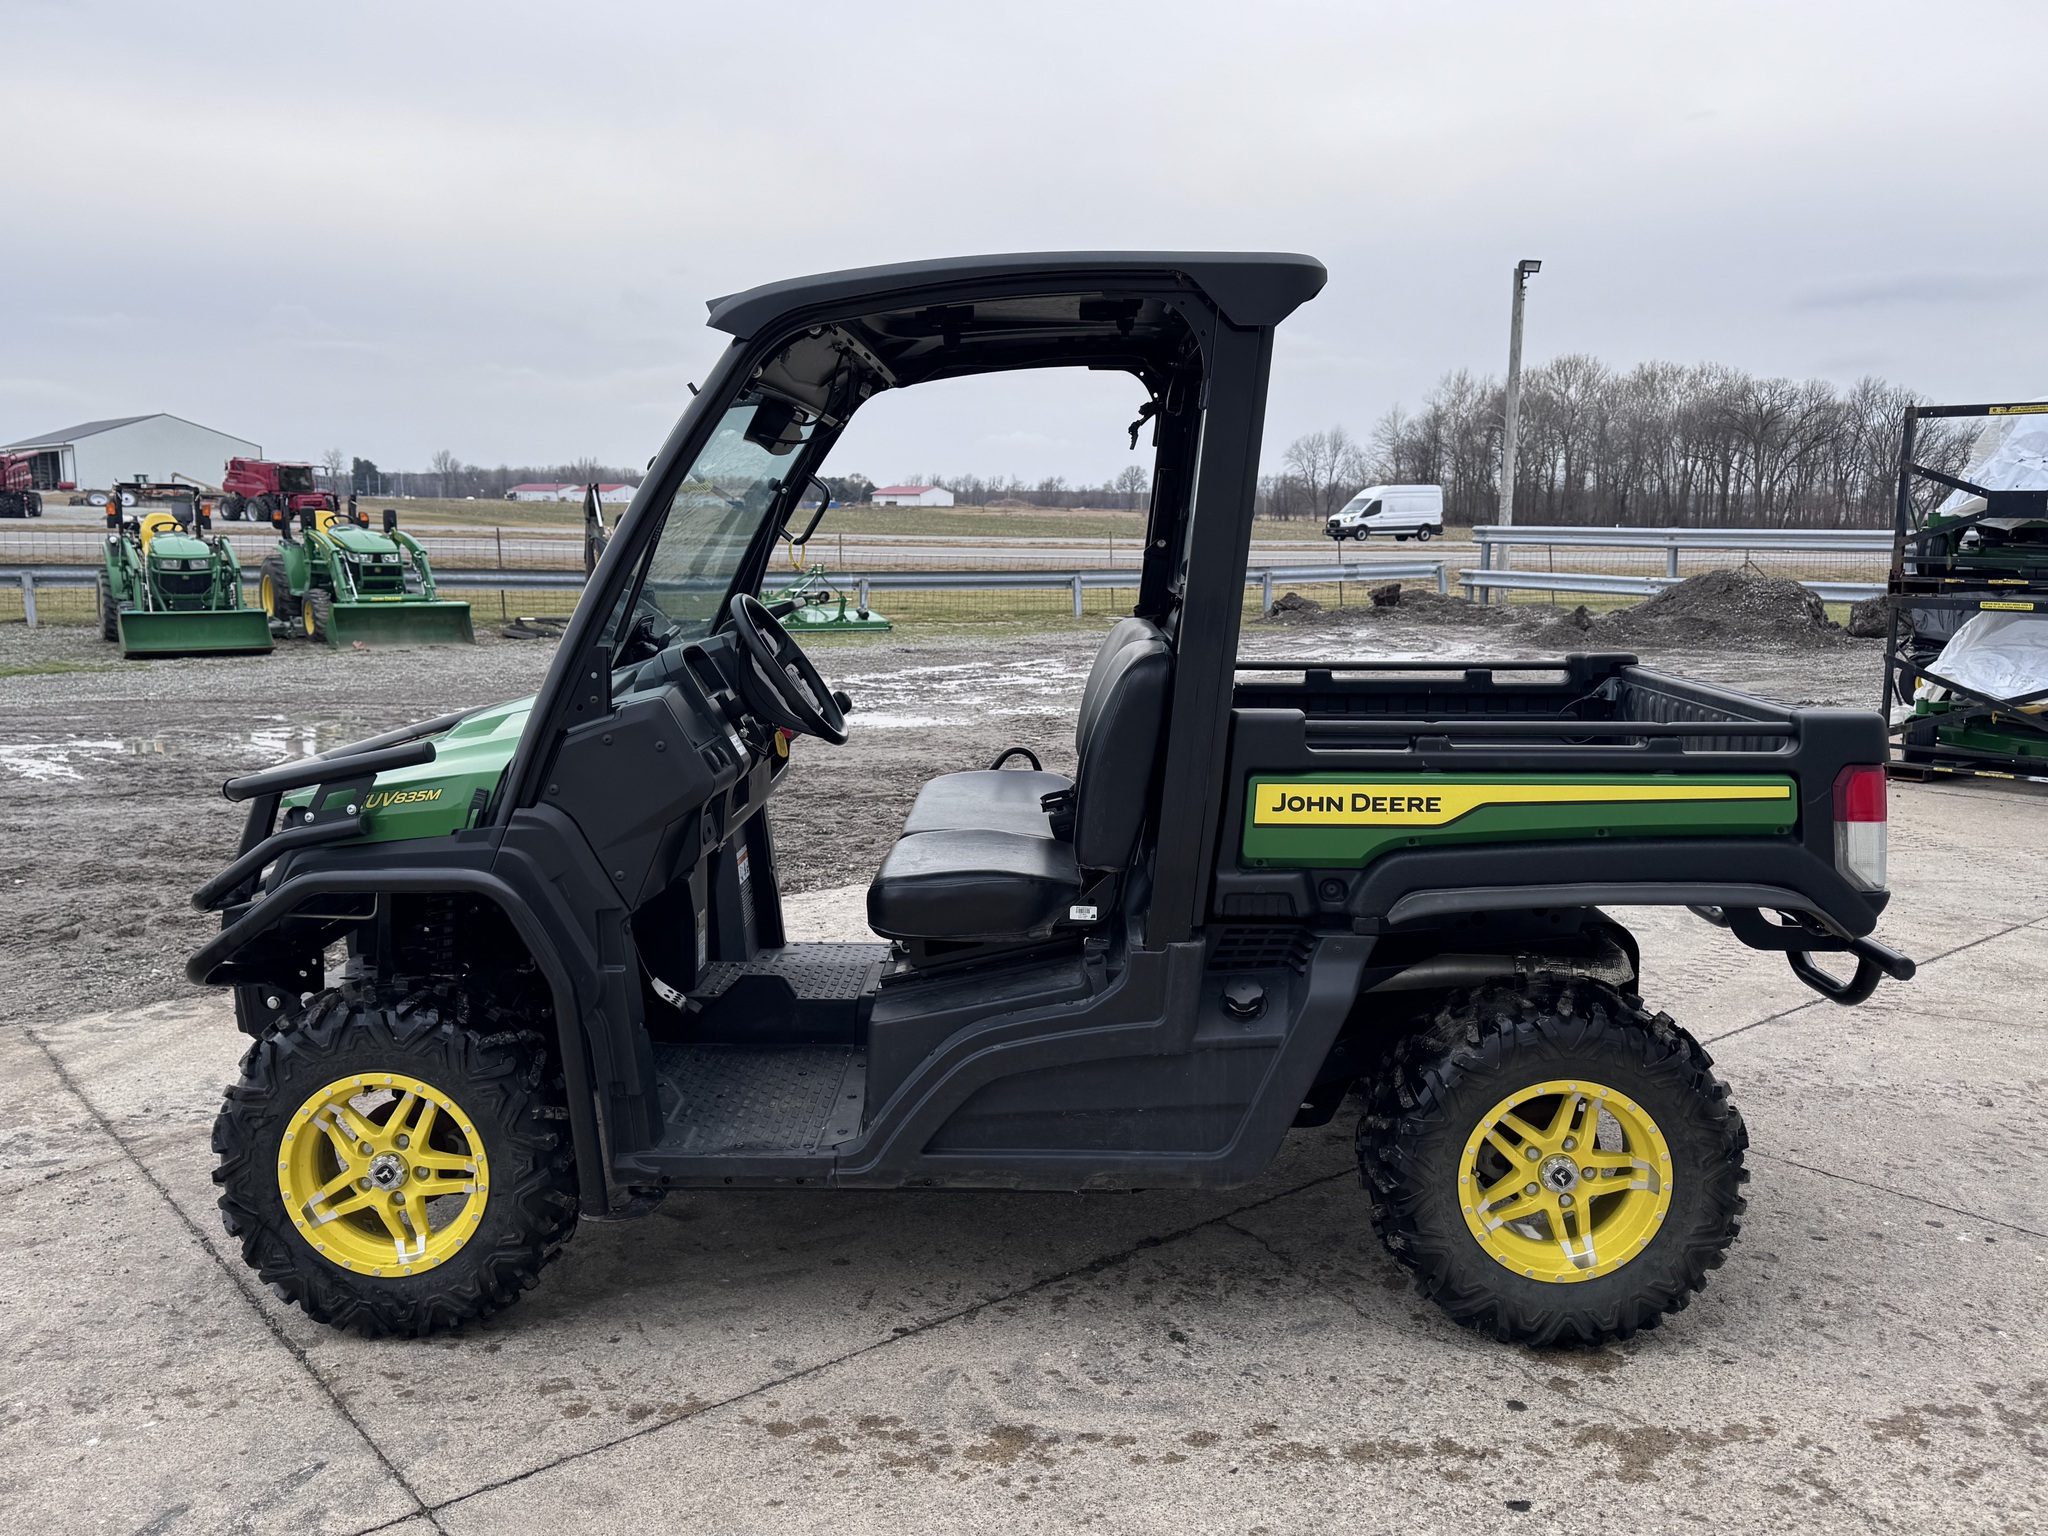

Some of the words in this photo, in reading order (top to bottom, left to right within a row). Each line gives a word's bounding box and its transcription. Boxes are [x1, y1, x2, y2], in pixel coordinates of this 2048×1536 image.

[360, 788, 443, 809] UV835M
[1272, 793, 1343, 812] JOHN
[1351, 793, 1441, 812] DEERE
